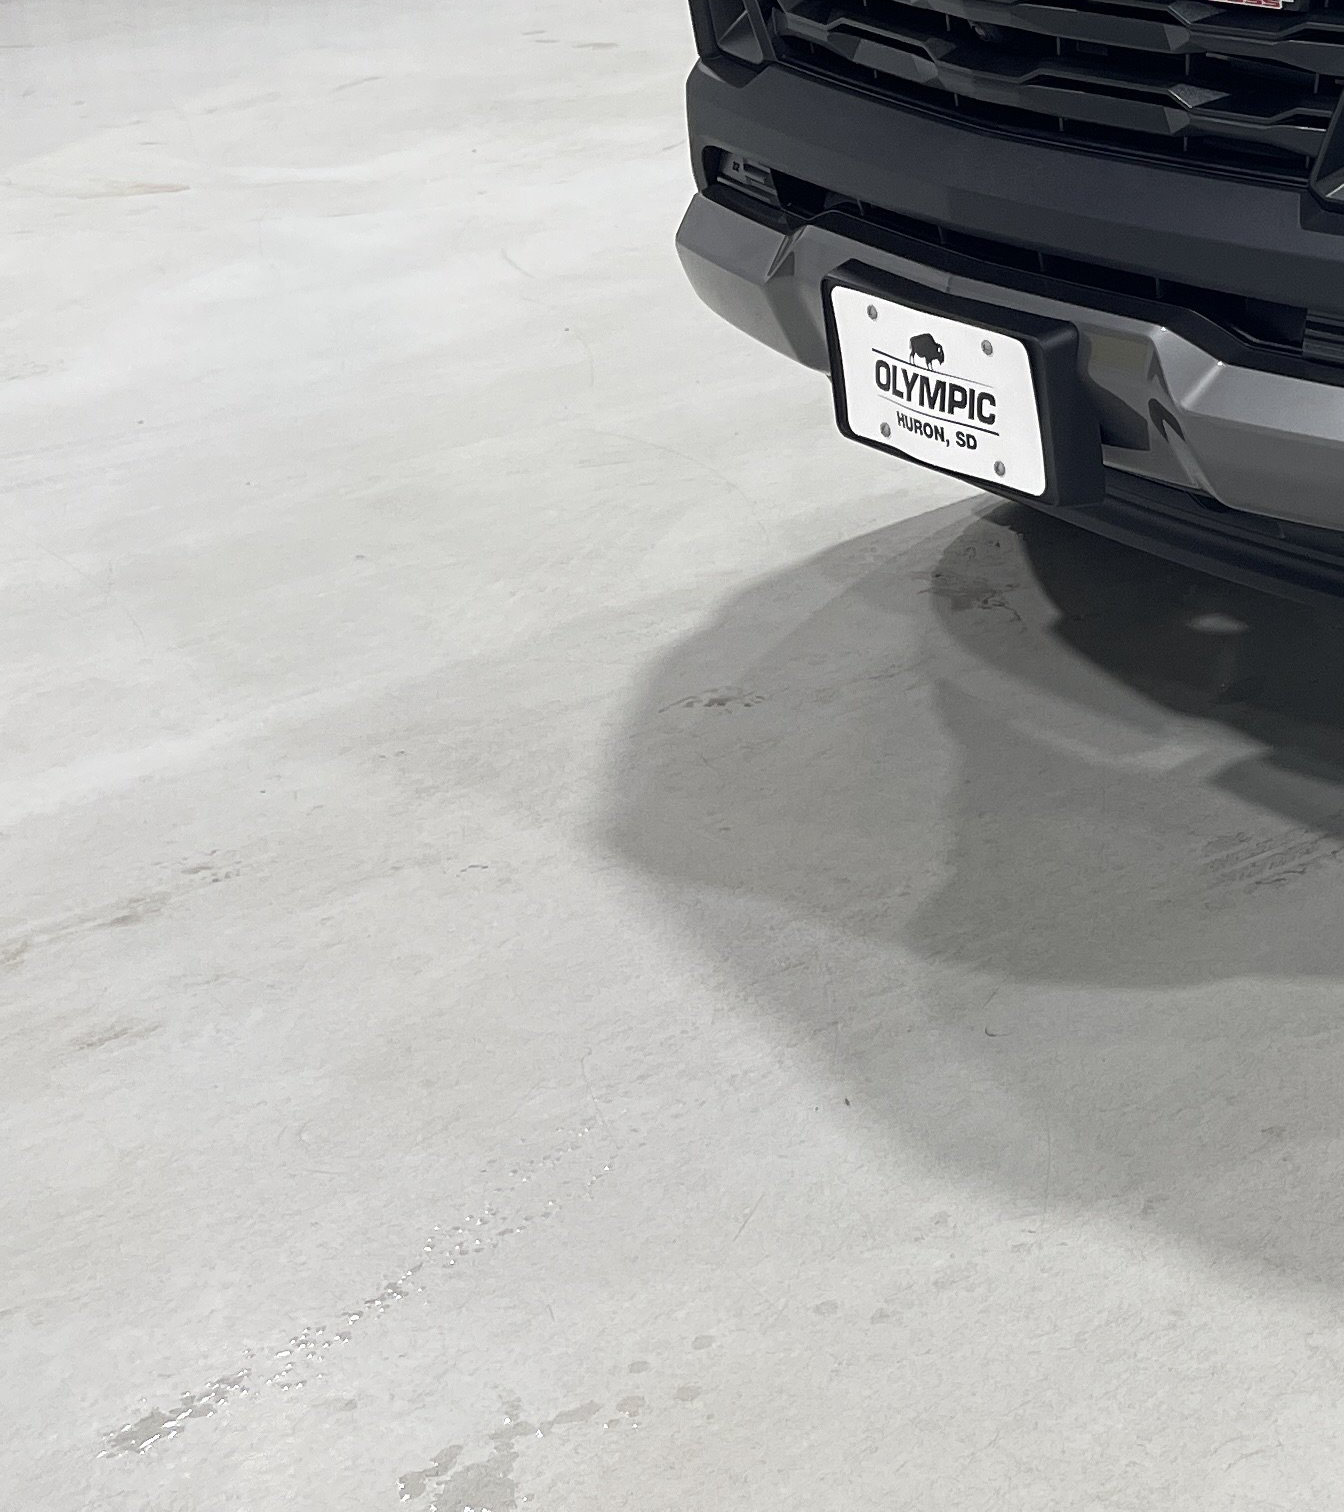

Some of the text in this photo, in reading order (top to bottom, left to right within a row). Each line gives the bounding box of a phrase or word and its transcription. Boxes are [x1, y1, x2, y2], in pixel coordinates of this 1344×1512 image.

[875, 360, 996, 425] OLYMPIC
[896, 411, 977, 450] HURON, SD
